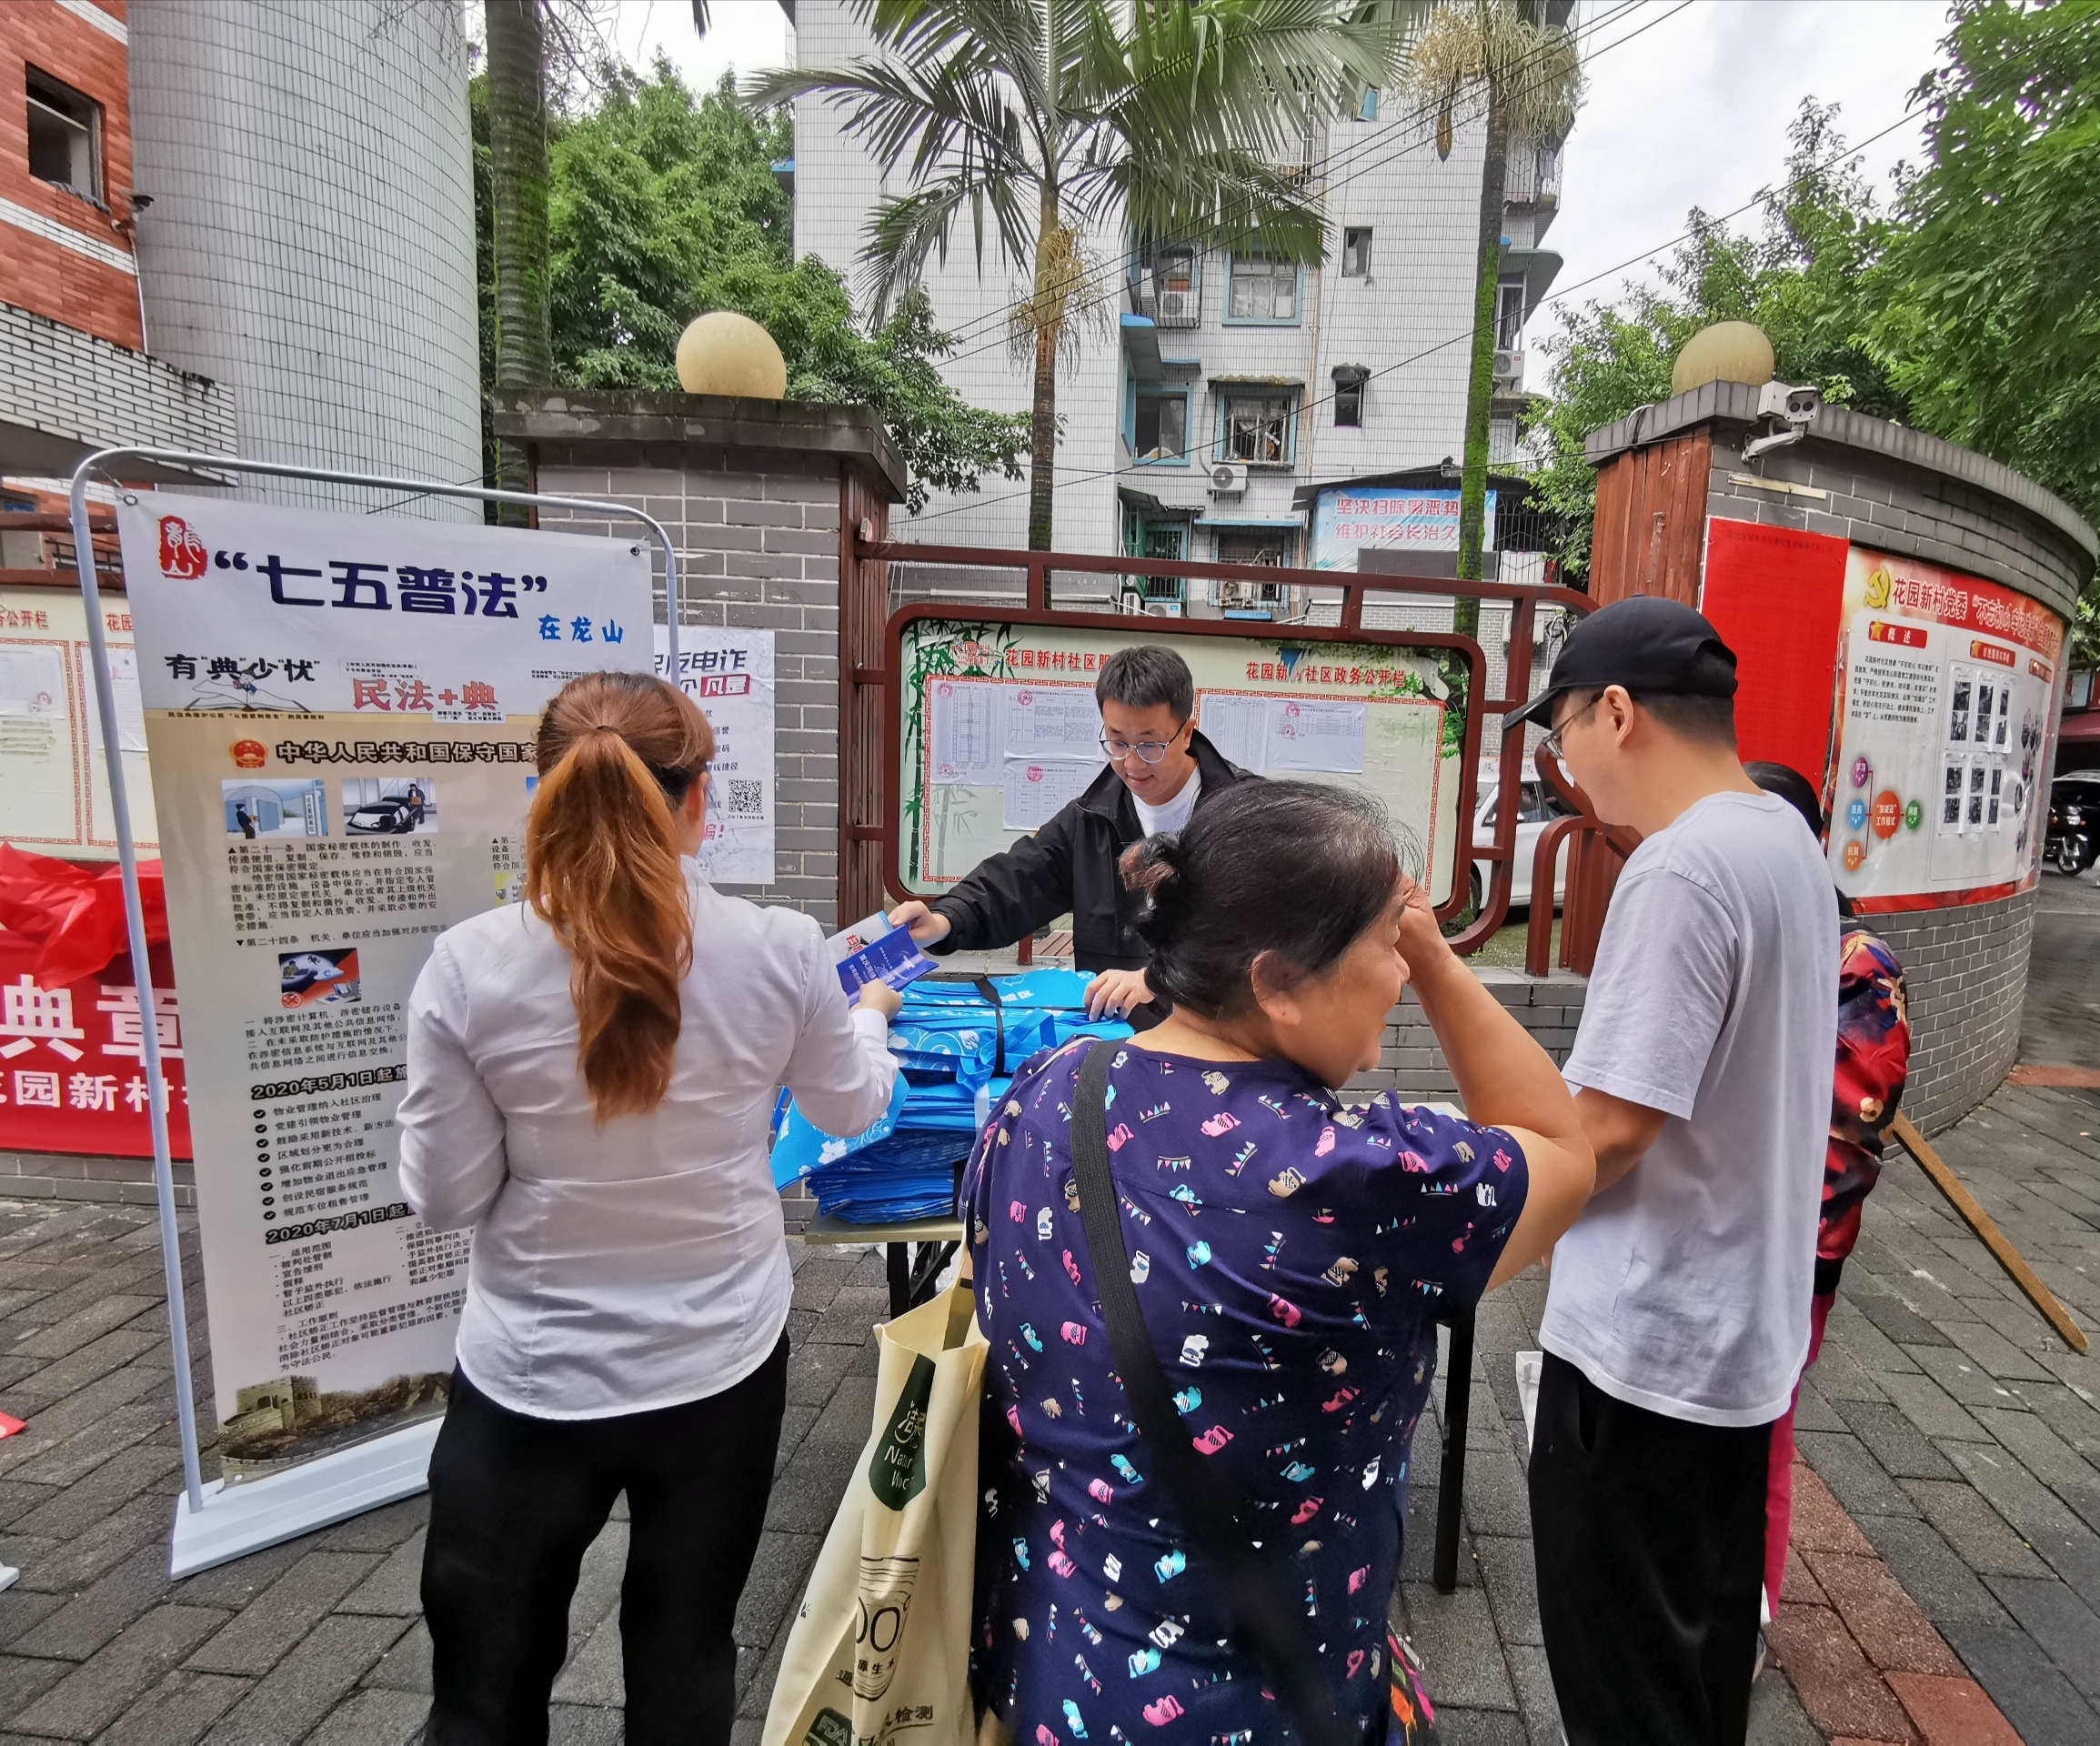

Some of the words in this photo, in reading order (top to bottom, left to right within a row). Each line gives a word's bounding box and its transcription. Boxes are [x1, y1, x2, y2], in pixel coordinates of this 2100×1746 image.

[215, 551, 548, 618] “七五普法”
[1893, 577, 1968, 621] 花园新村党委
[538, 614, 624, 644] 在龙山
[1246, 661, 1406, 687] 花园新社区政务公开栏
[353, 678, 499, 711] 民法+典
[276, 741, 537, 763] 中华人民共和国保守国家
[0, 1070, 188, 1112] 园新村
[274, 1093, 382, 1116] 物业管理纳入社区治理
[275, 1110, 362, 1131] 党建引领物业管理
[277, 1138, 364, 1159] 区域划分更为合理
[279, 1149, 377, 1174] 强化前期公开招投标
[281, 1161, 387, 1188] 增加物业退出应急管理
[283, 1179, 368, 1202] 创设民宿服务规范
[284, 1193, 369, 1217] 规范车位租售管理
[266, 1202, 417, 1244] 2020年7月1日起
